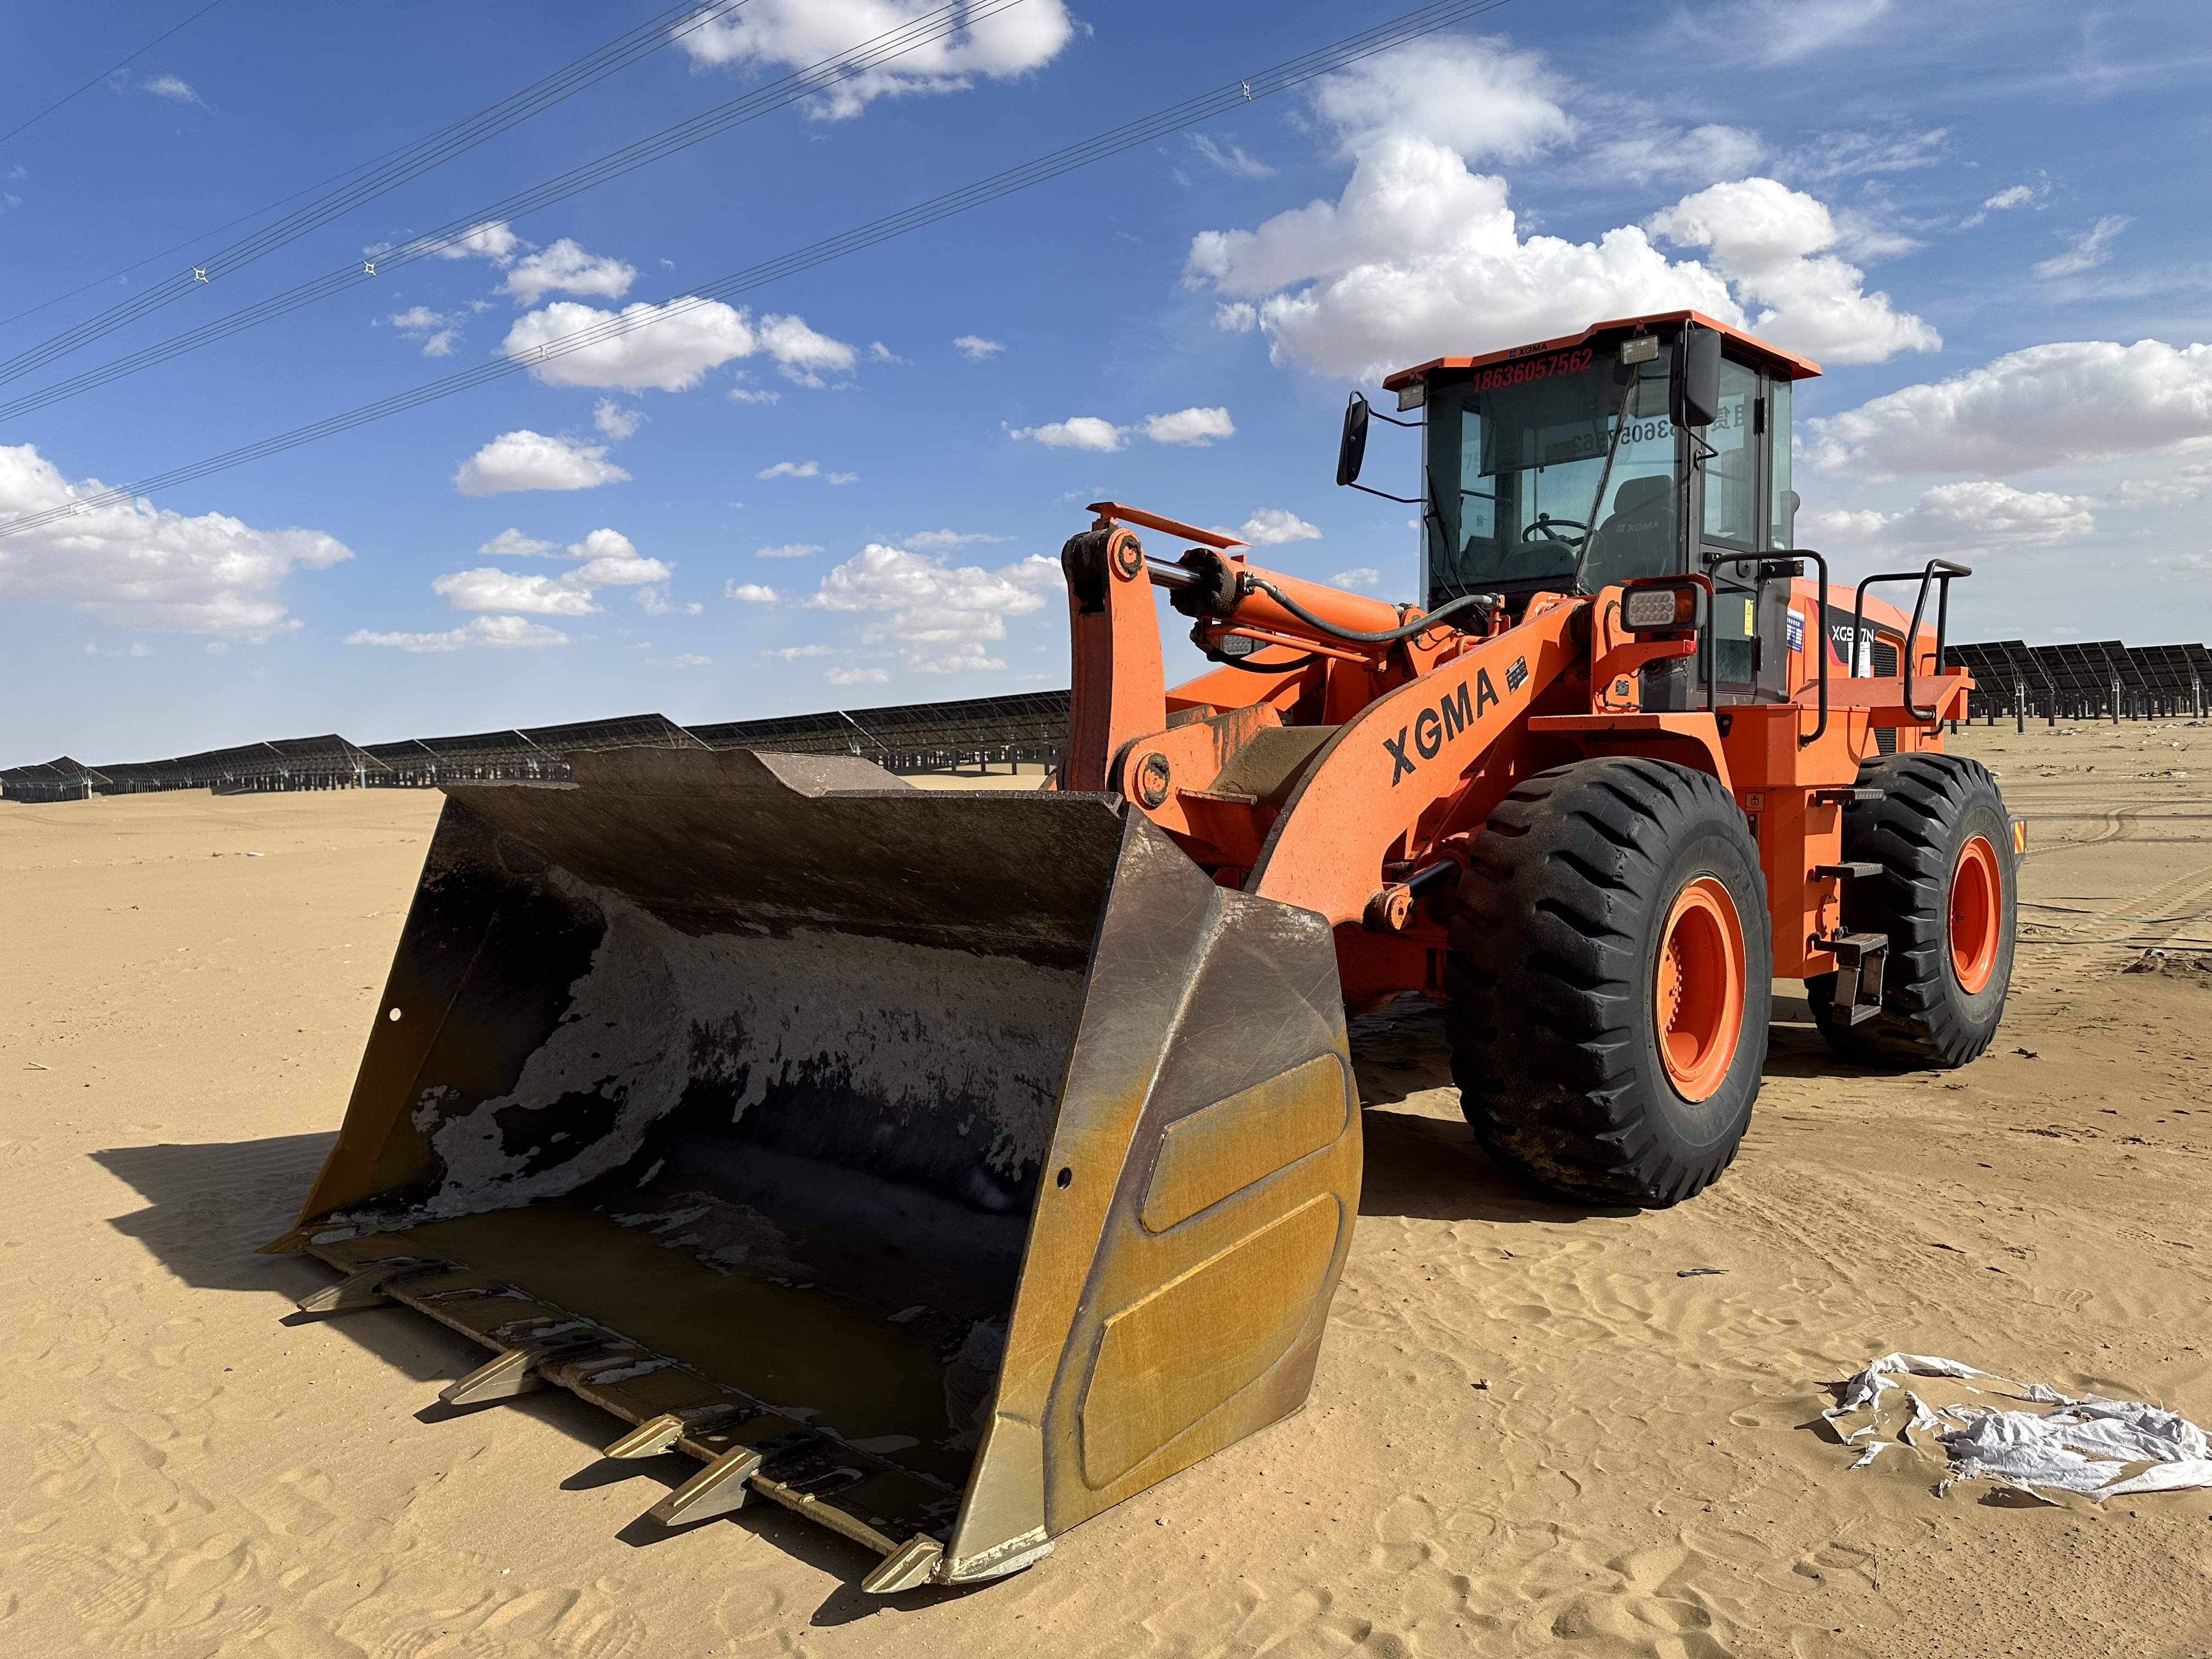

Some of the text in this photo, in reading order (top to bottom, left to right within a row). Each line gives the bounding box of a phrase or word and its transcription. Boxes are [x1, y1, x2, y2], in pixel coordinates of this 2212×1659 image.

[1519, 343, 1548, 356] XGMA
[1474, 348, 1592, 393] 18636057562
[1832, 625, 1874, 642] XG97N
[1383, 667, 1499, 788] XGMA
